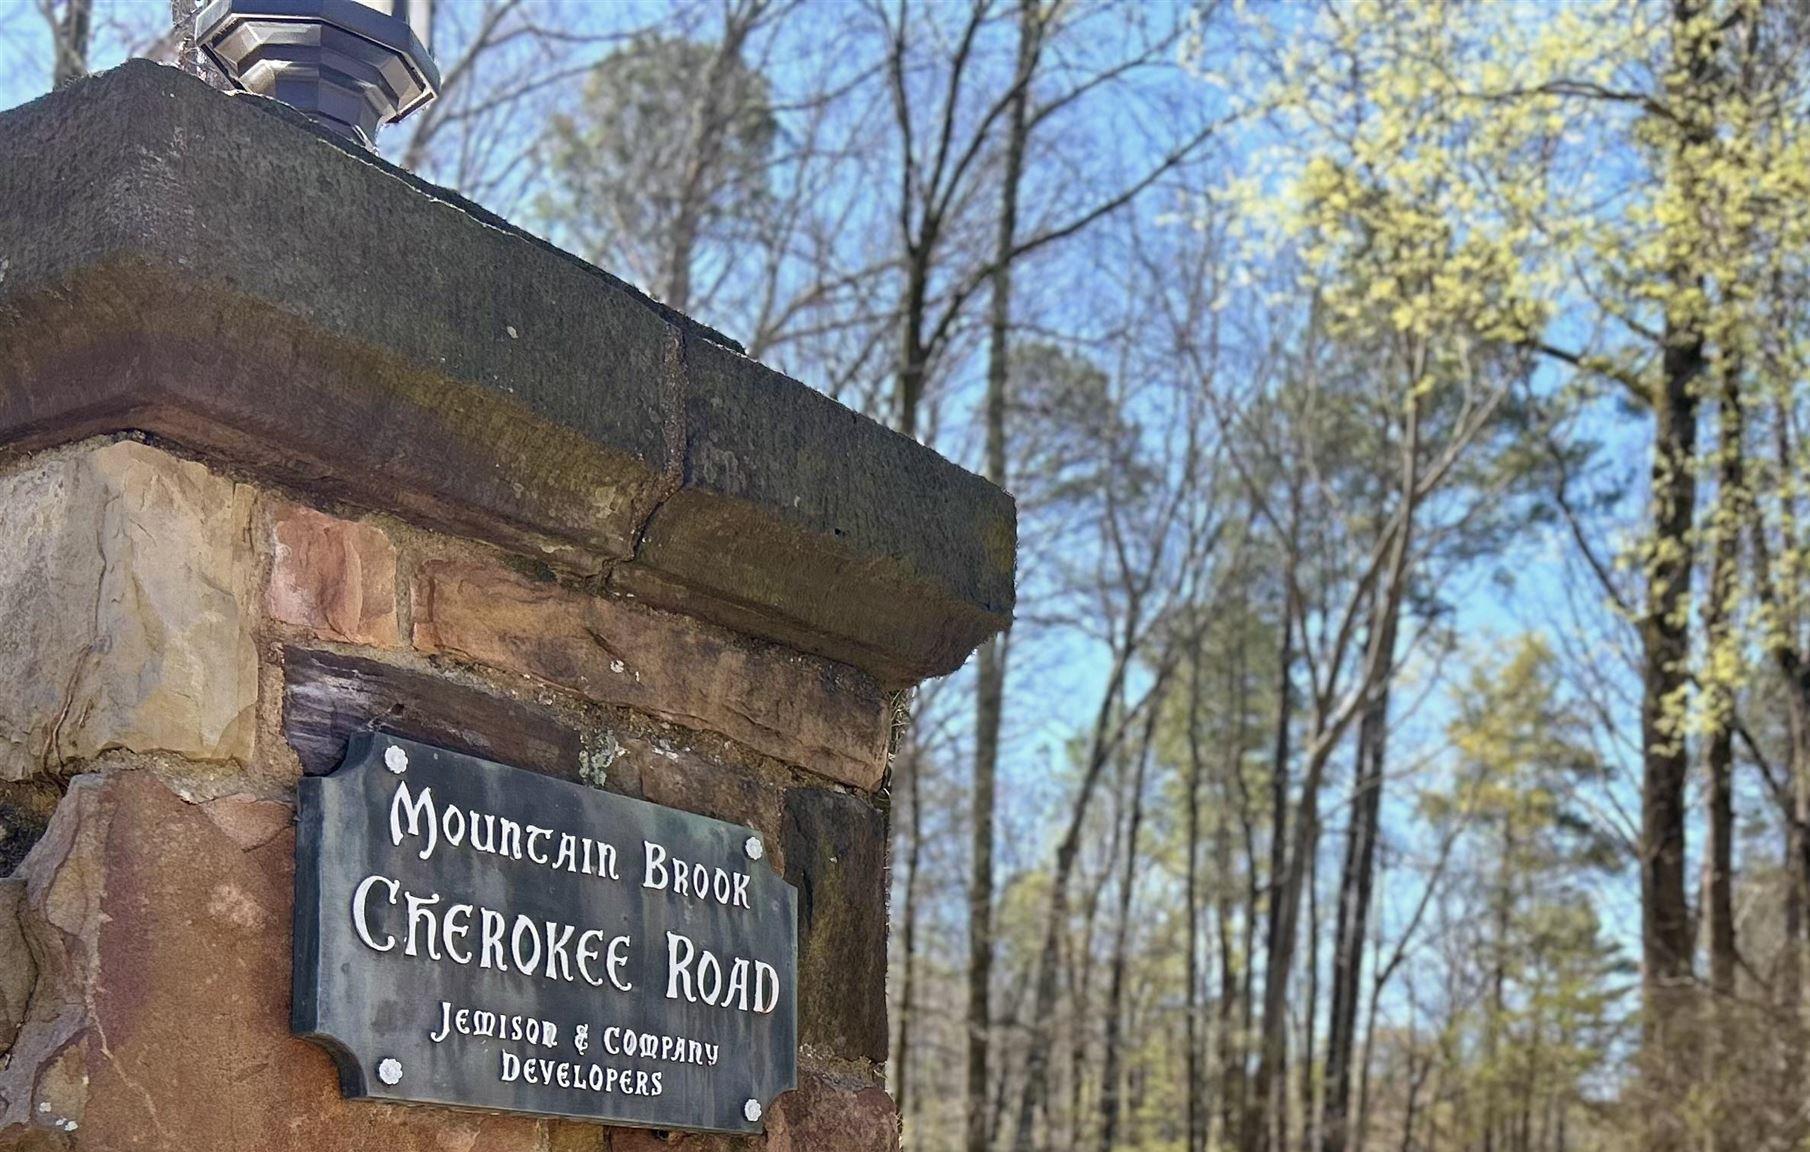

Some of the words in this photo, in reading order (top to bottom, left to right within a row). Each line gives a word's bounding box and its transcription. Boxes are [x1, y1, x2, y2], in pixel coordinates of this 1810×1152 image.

[390, 780, 619, 880] MOUNTAIN
[643, 840, 751, 909] BROOK
[353, 875, 632, 991] CHEROKEE
[666, 931, 780, 1014] ROAD
[431, 1002, 558, 1048] JEMISON
[574, 1024, 590, 1052] &
[604, 1026, 720, 1066] COMPANY
[501, 1051, 663, 1096] DEVELOPERS
